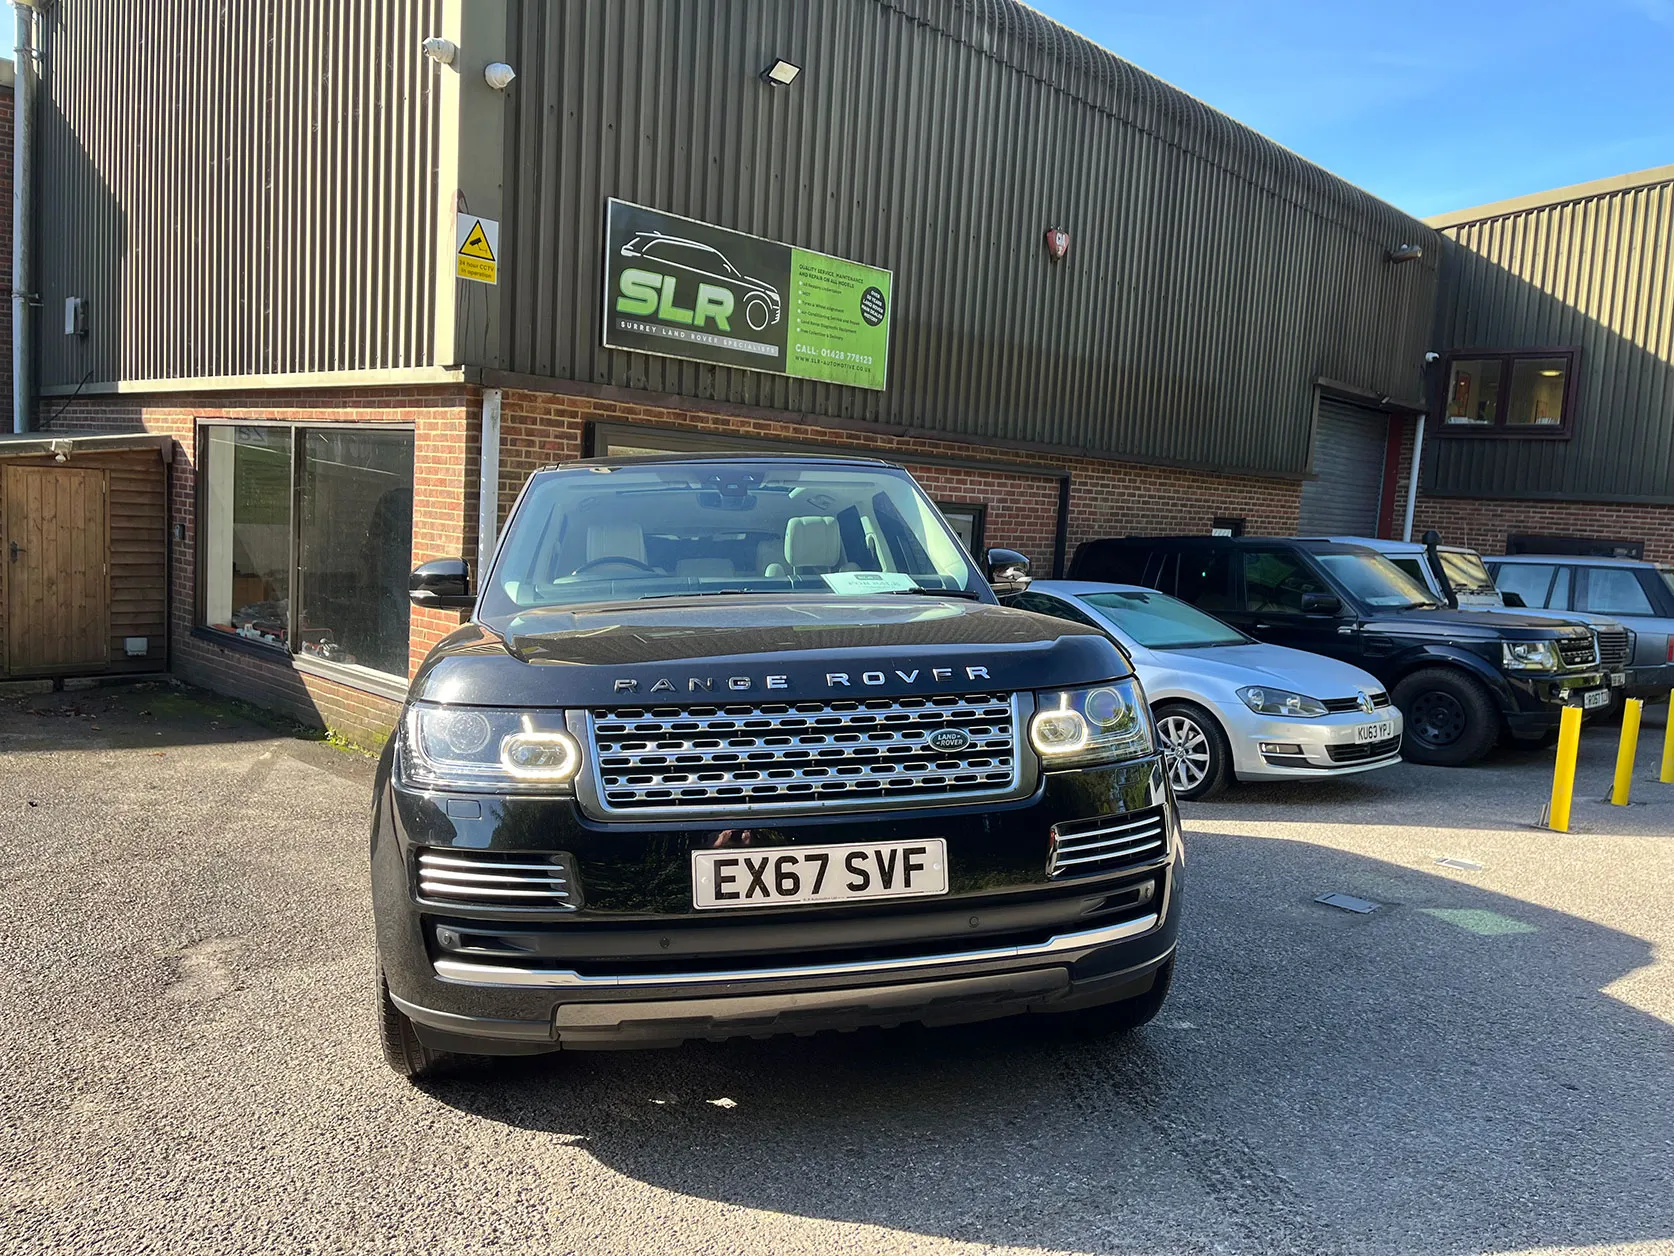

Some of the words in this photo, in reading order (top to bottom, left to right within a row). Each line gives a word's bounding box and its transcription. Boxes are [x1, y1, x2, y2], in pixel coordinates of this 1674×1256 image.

[466, 261, 479, 269] hour
[479, 263, 495, 272] CCTV
[798, 263, 817, 272] QUALITY
[468, 269, 492, 279] operation
[616, 268, 735, 332] SLR
[620, 320, 657, 334] SURREY
[662, 328, 686, 339] LAND
[691, 333, 718, 345] ROVER
[723, 339, 776, 354] SPECIALISTS
[614, 674, 788, 694] RANGE
[826, 665, 991, 688] ROVER
[938, 733, 957, 741] LAND
[1358, 725, 1378, 741] KU63
[940, 739, 964, 747] ROVER
[713, 852, 830, 901] EX67
[845, 846, 927, 892] SVF
